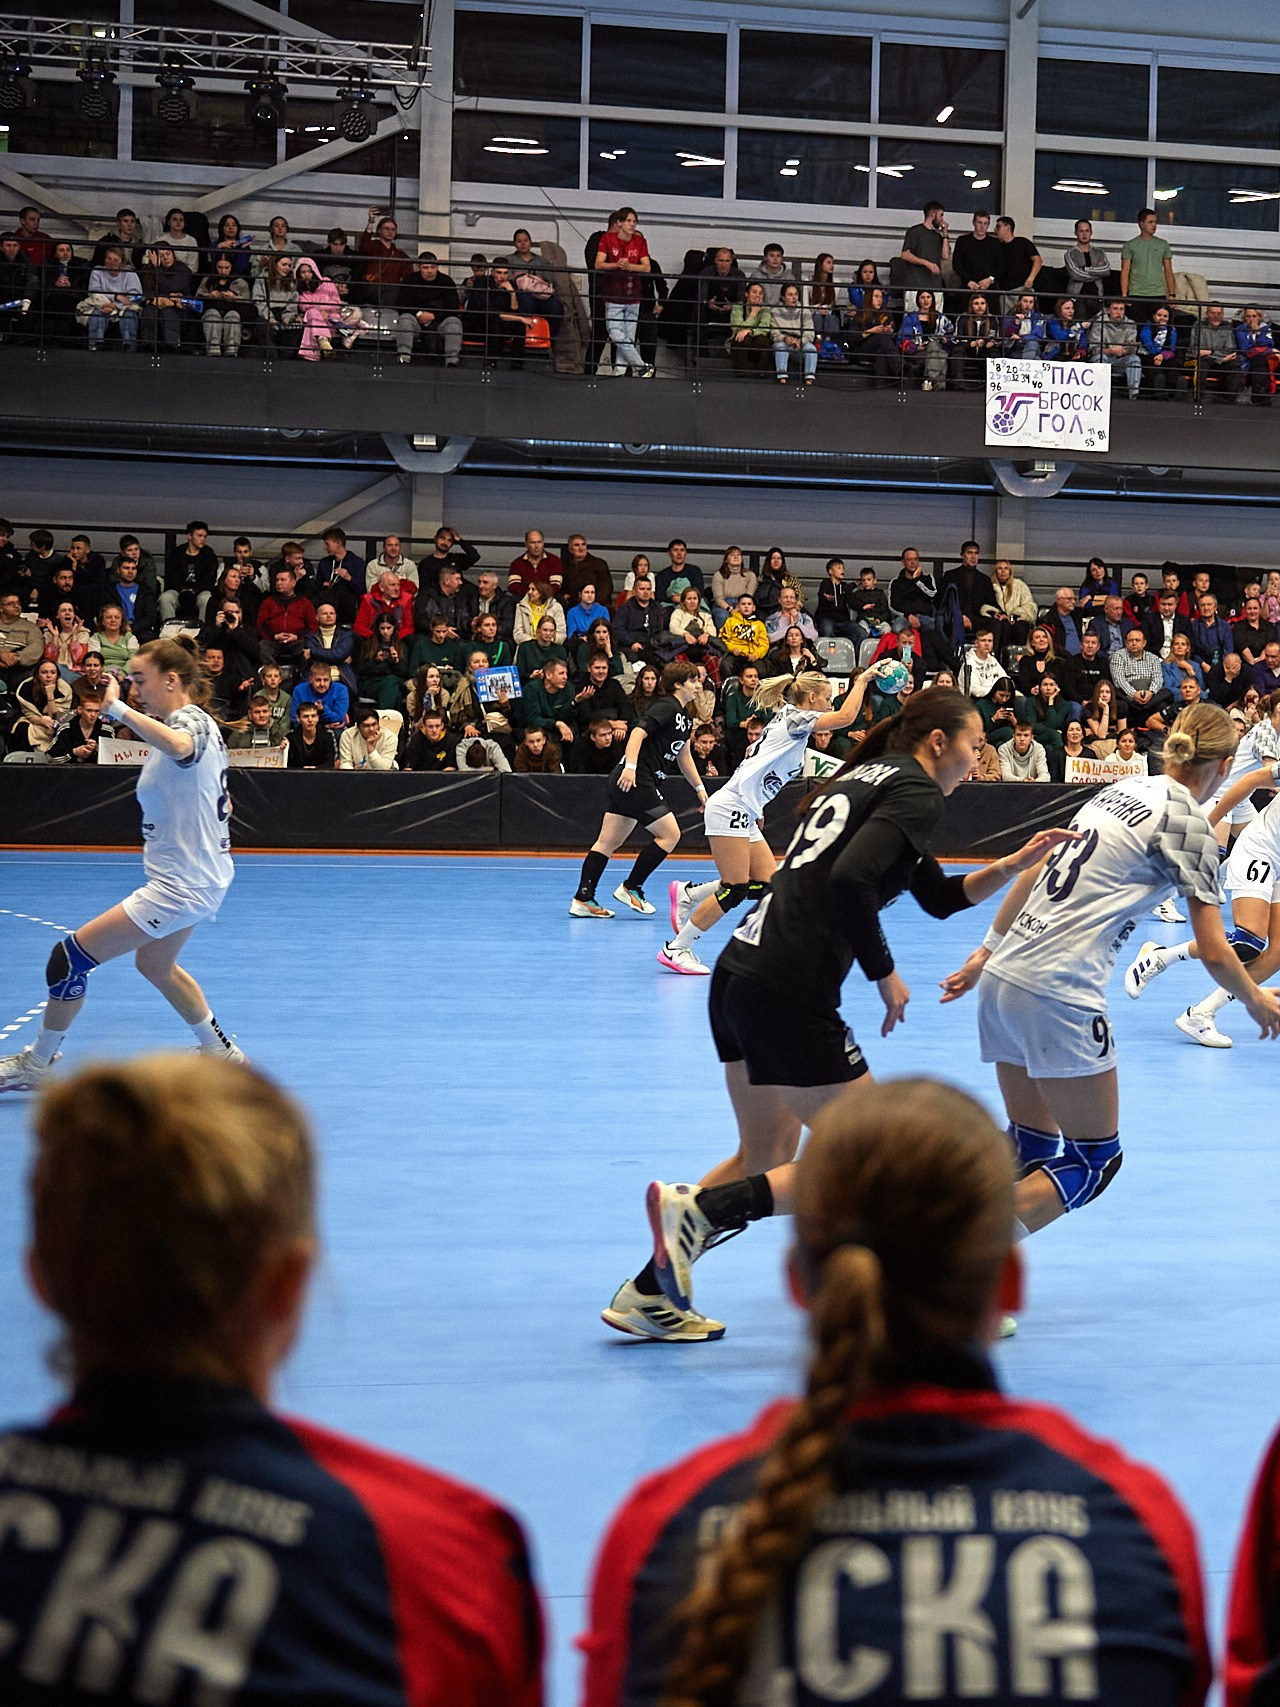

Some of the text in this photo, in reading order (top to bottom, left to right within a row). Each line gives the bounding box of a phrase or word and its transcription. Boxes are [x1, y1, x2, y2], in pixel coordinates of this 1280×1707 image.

[996, 363, 1001, 371] 8
[1006, 365, 1018, 373] 20
[1020, 362, 1031, 371] 22
[1012, 373, 1019, 381] 32
[1051, 366, 1094, 386] ПАС
[990, 380, 1043, 391] 96 40
[1038, 391, 1103, 412] БРОСОК
[1039, 413, 1083, 435] ГОЛ
[675, 712, 687, 733] 96
[1246, 859, 1272, 884] 67
[990, 1488, 1092, 1539] КЛУБ
